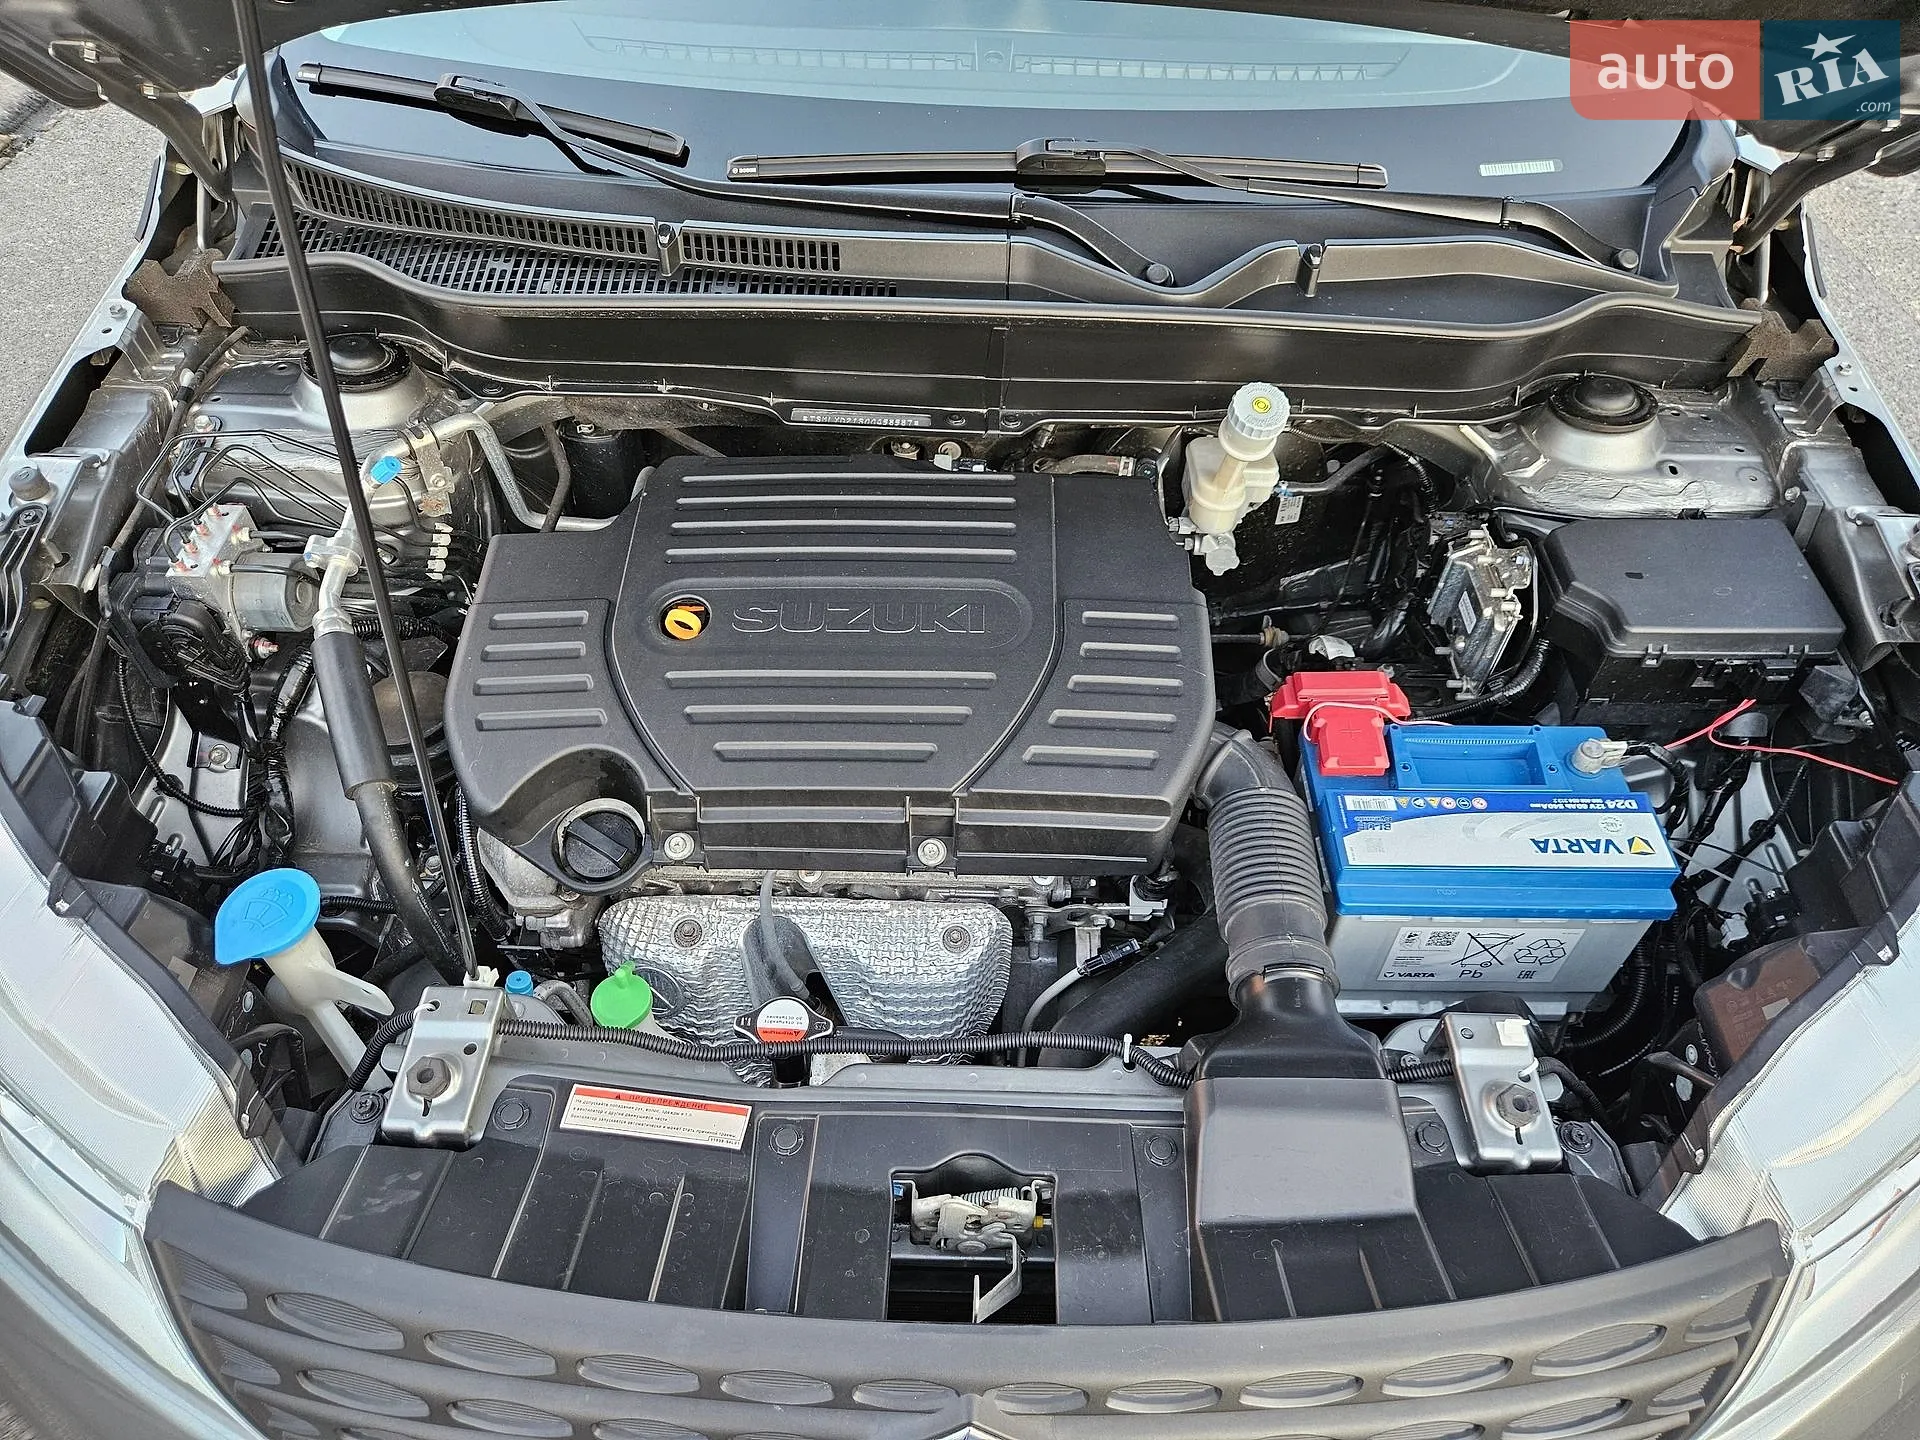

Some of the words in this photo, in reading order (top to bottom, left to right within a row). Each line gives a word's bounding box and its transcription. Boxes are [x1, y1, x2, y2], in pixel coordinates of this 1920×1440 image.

[732, 601, 986, 634] SUZUKI
[1605, 799, 1638, 810] D24
[1530, 838, 1624, 854] VARTA
[1459, 969, 1483, 978] Pb
